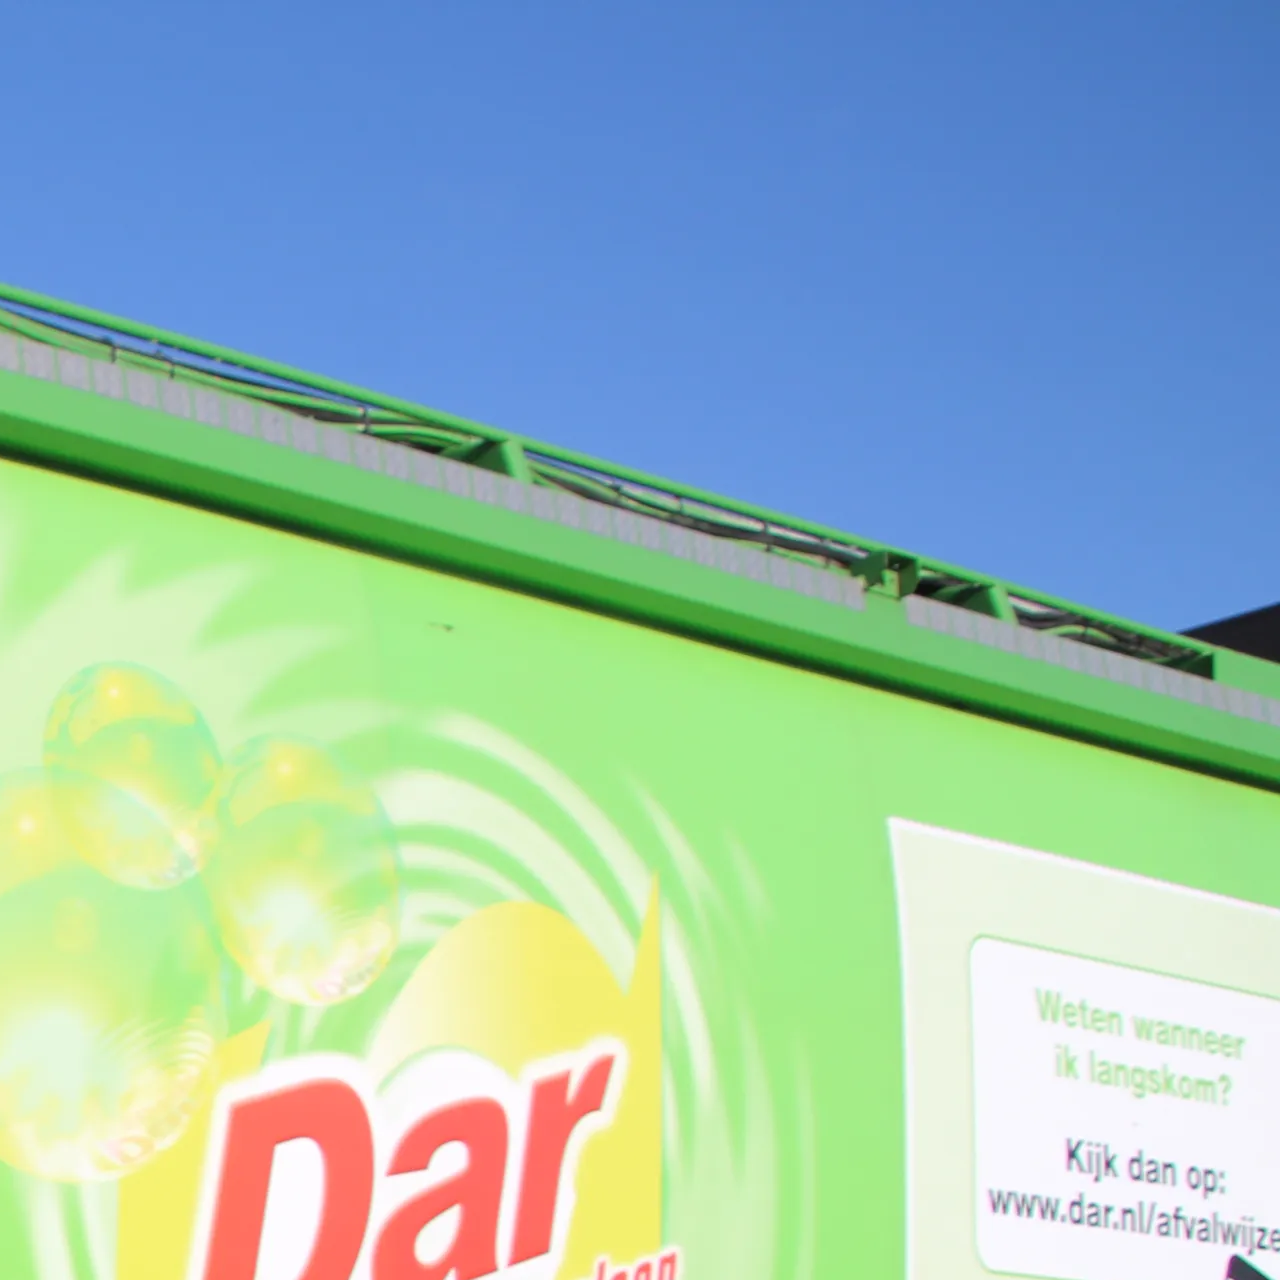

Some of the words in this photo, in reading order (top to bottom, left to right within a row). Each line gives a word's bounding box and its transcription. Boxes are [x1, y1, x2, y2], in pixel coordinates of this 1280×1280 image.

[1035, 988, 1122, 1037] Weten
[1133, 1013, 1246, 1060] wanneer
[1054, 1044, 1078, 1080] ik
[1089, 1050, 1232, 1105] langskom?
[1065, 1137, 1120, 1182] Kijk
[1127, 1149, 1176, 1187] dan
[1186, 1164, 1226, 1197] op:
